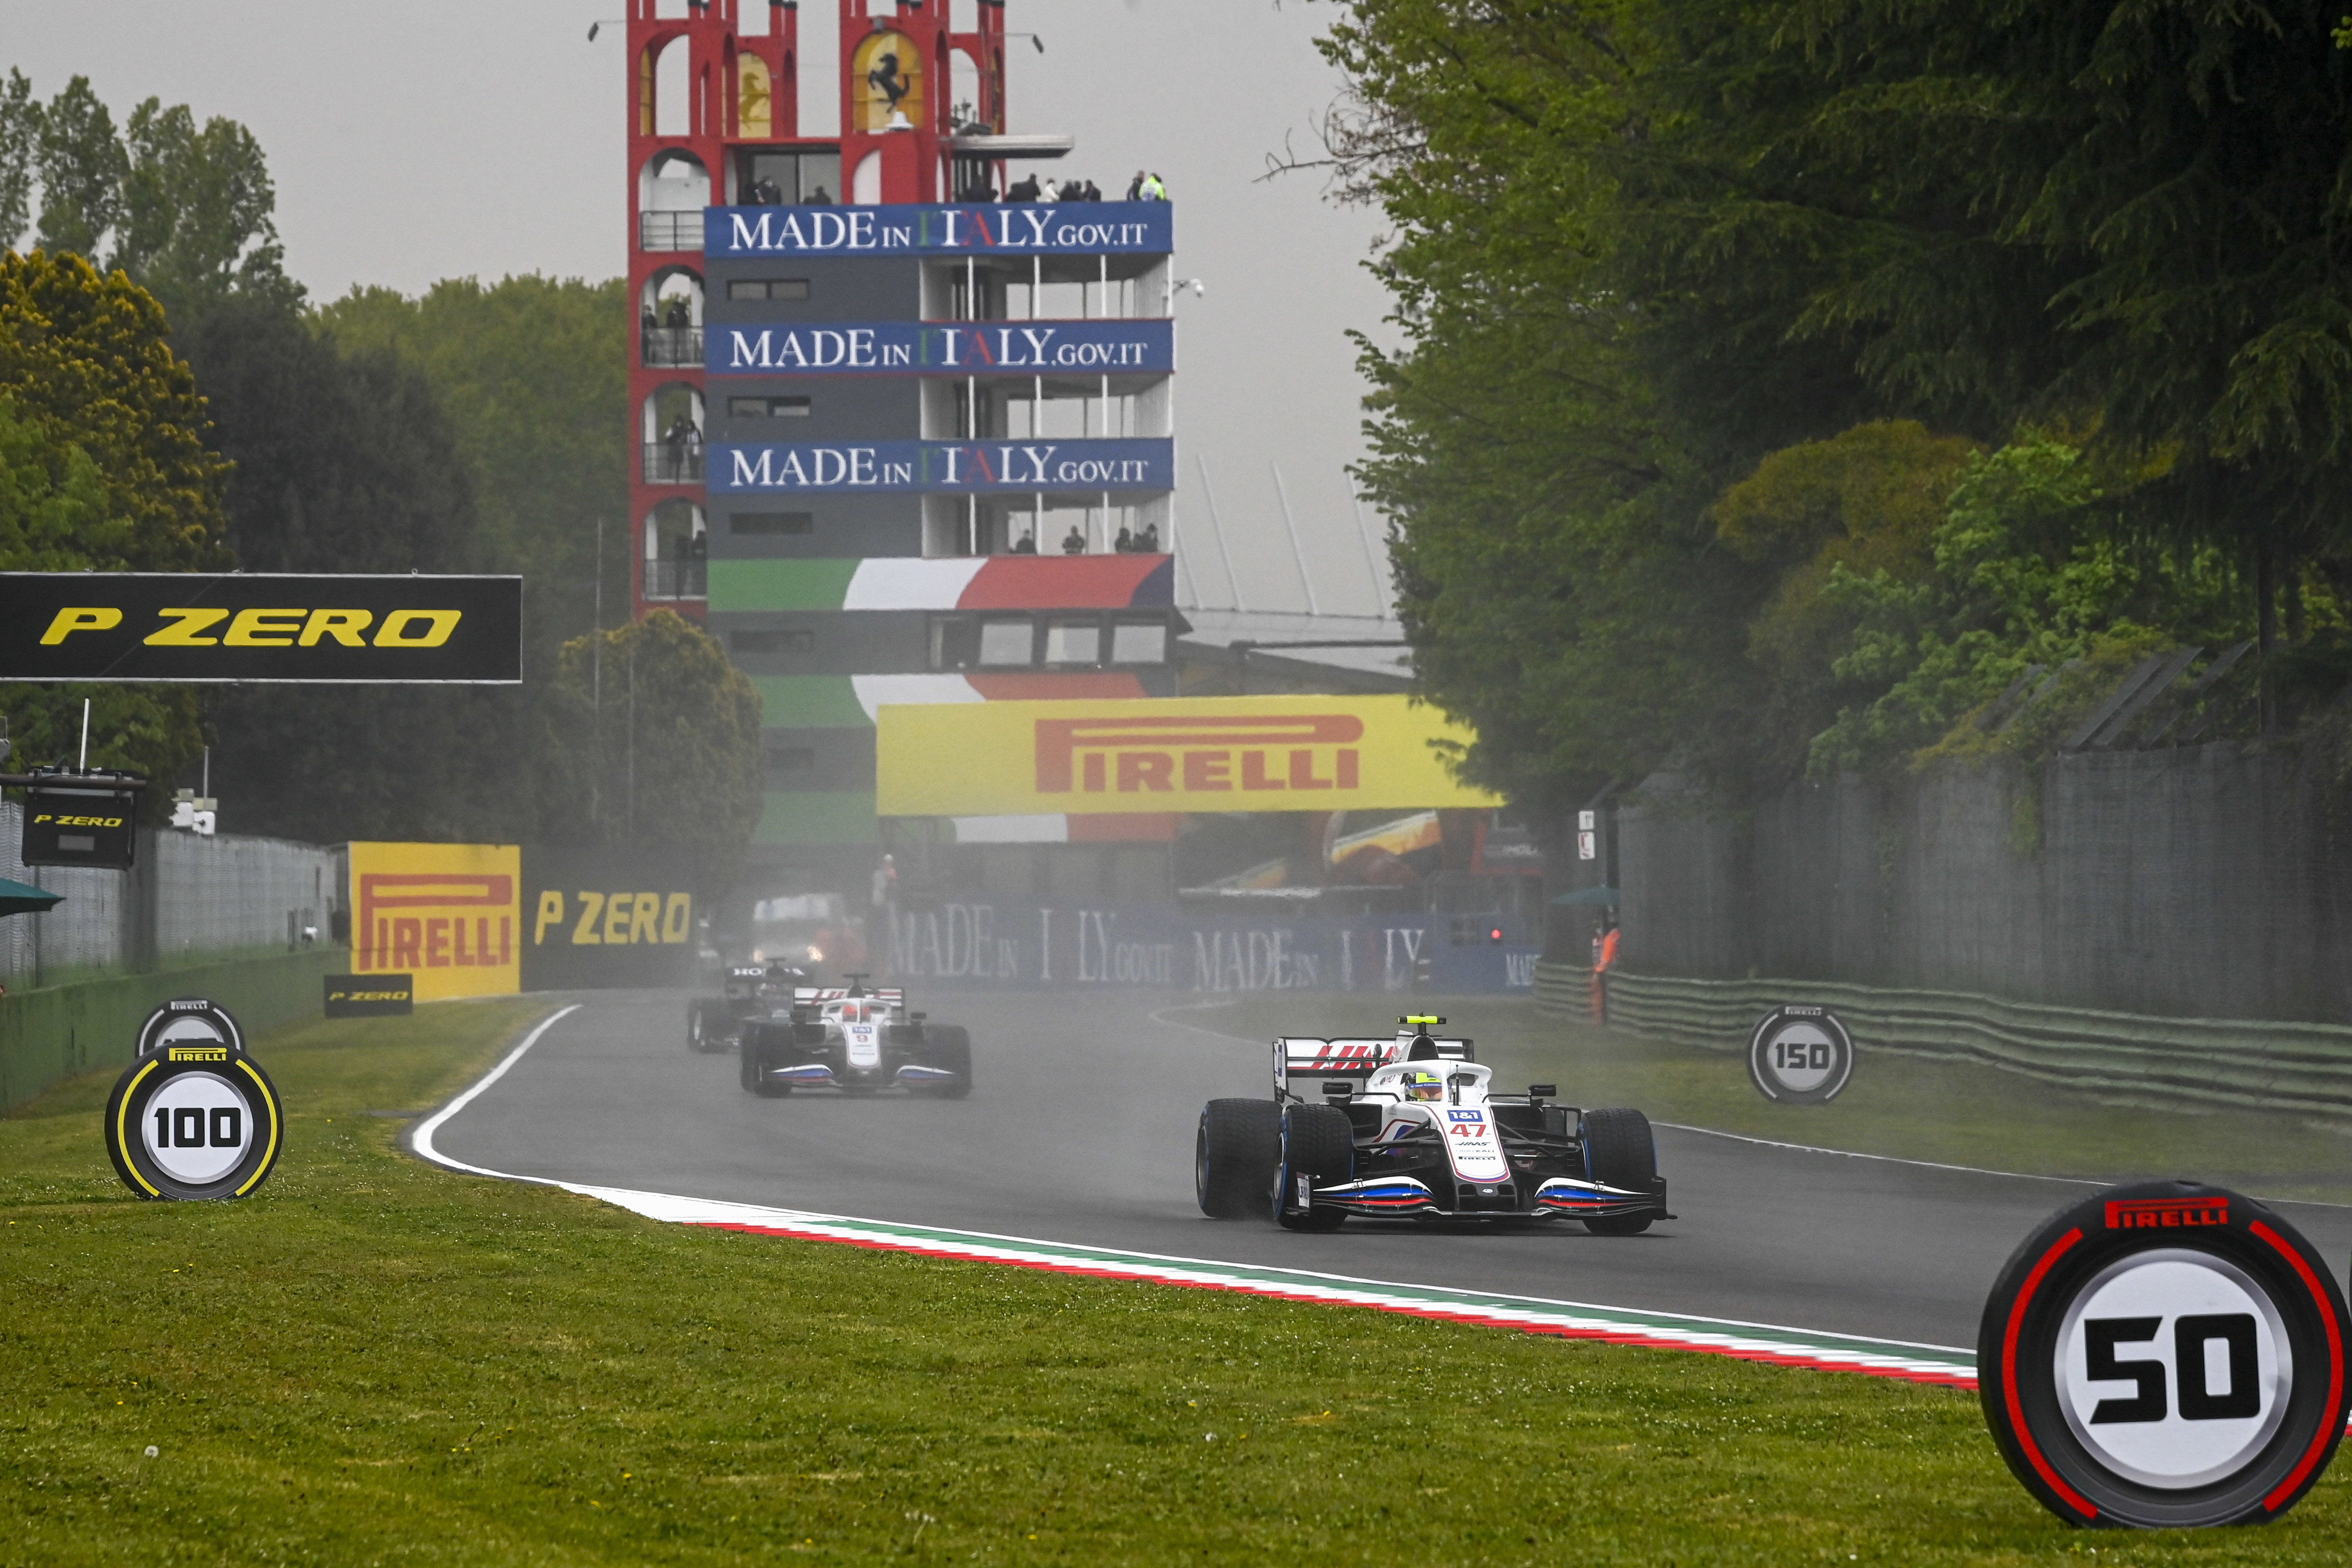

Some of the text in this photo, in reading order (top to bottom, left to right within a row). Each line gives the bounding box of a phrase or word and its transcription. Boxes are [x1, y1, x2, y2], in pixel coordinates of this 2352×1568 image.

[729, 212, 877, 250] MADE
[882, 227, 911, 248] IN
[729, 330, 877, 369] MADE
[882, 345, 911, 366] IN
[730, 448, 879, 486] MADE
[883, 463, 912, 484] IN
[40, 607, 462, 647] P ZERO
[1034, 714, 1364, 793] PIRELLI
[34, 814, 122, 827] P ZERO
[359, 874, 512, 971] PIRELLI
[535, 891, 691, 945] P ZERO
[1192, 929, 1293, 992] MADE
[170, 1000, 208, 1011] PIRELLI
[329, 991, 409, 1001] P ZERO
[169, 1047, 227, 1062] PIRELLI
[1776, 1042, 1830, 1070] 150
[154, 1107, 241, 1148] 100
[1450, 1124, 1486, 1137] 47
[2105, 1197, 2228, 1229] PIRELLI
[2084, 1313, 2261, 1425] 50
